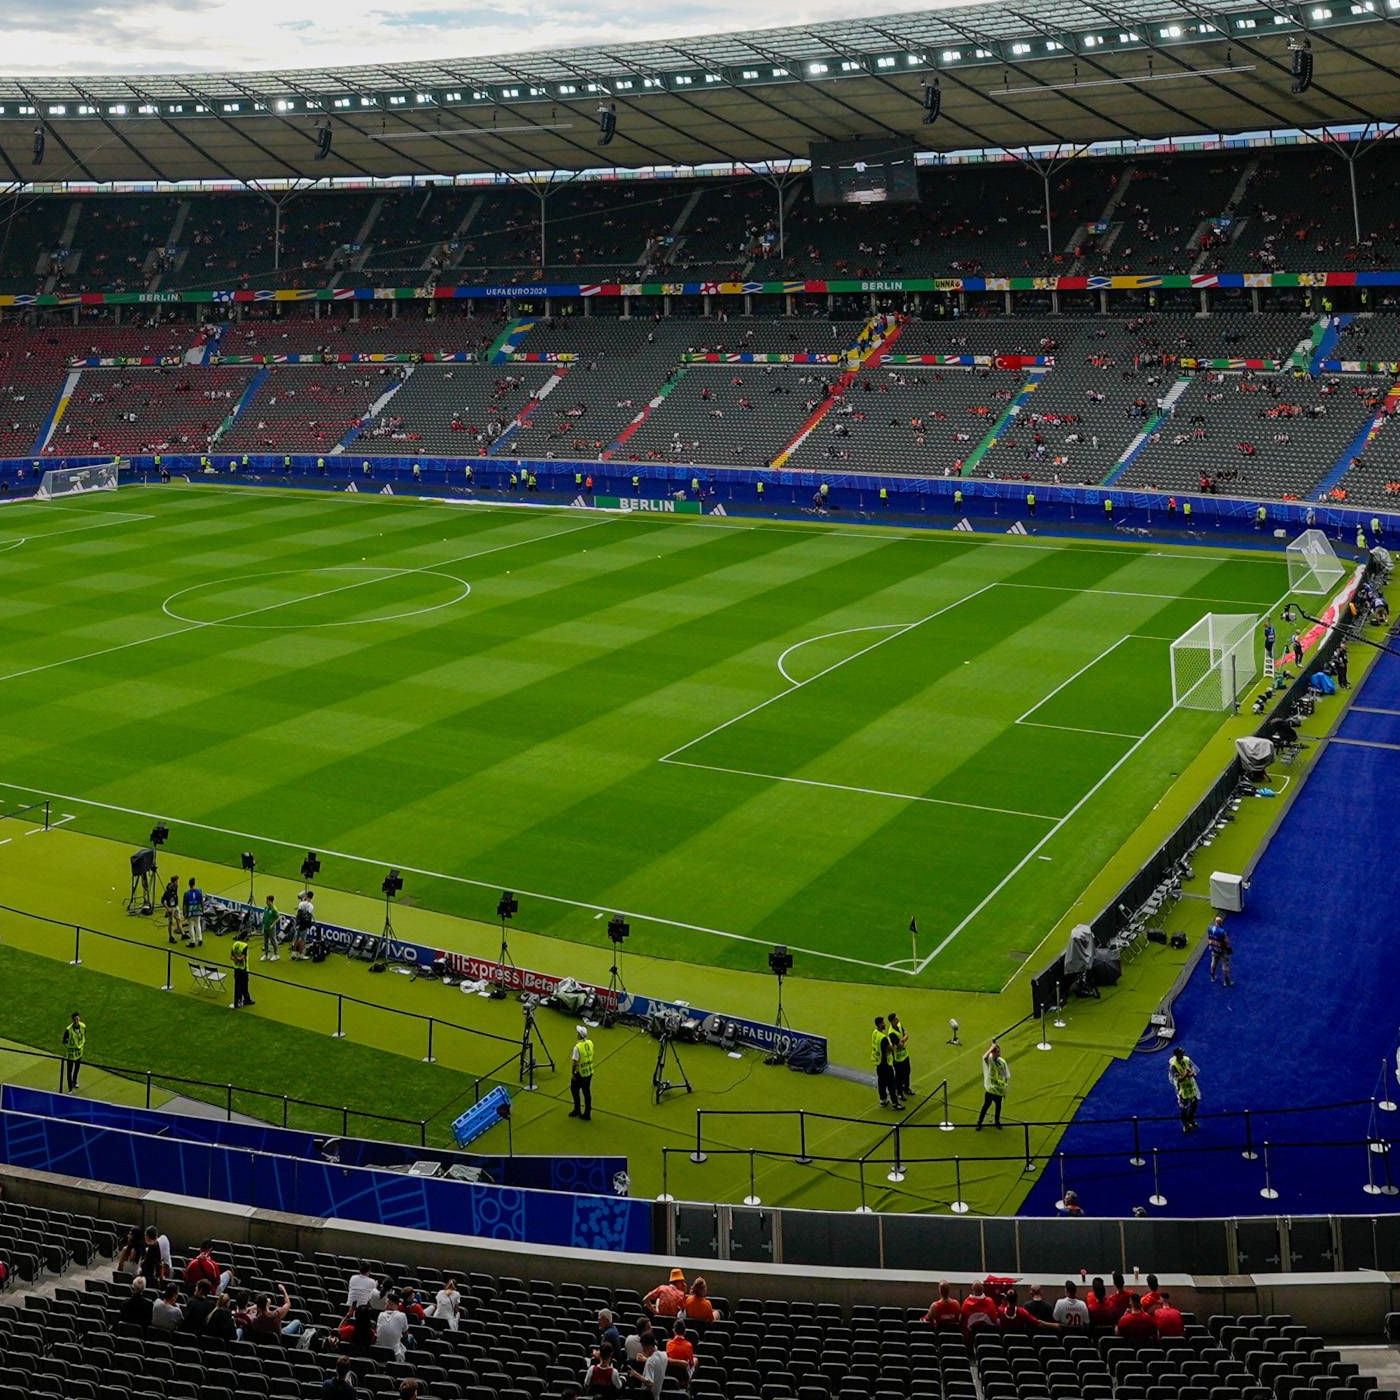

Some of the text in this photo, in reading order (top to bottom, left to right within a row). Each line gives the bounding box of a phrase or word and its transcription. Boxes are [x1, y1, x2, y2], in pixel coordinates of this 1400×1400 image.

[861, 281, 903, 291] BERLIN
[935, 280, 955, 289] UNNA
[138, 293, 180, 303] BERLIN
[619, 497, 675, 513] BERLIN
[1066, 1313, 1081, 1326] 20
